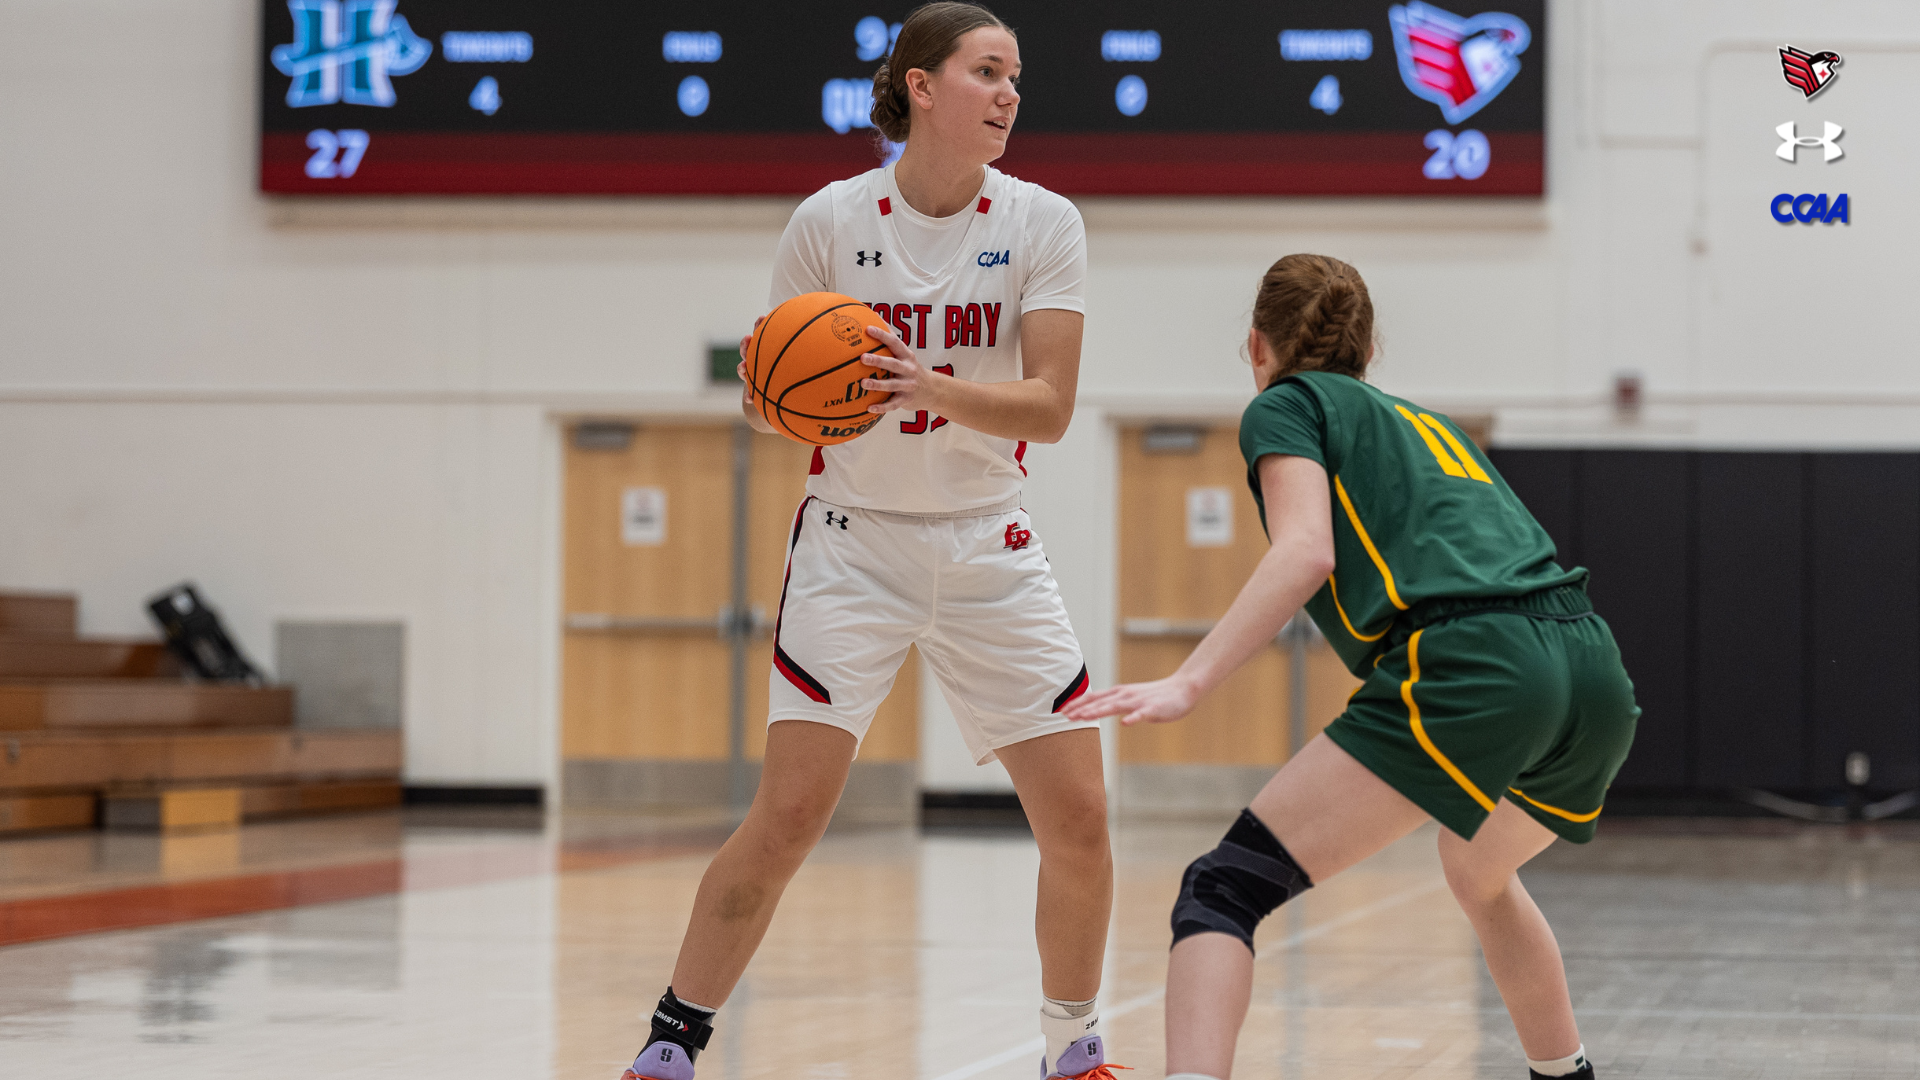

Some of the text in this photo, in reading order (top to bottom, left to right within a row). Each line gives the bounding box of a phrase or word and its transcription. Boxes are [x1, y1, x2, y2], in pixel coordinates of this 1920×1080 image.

[468, 76, 501, 115] 4
[677, 75, 710, 117] 0
[1115, 74, 1148, 117] 0
[1309, 74, 1343, 115] 4
[304, 129, 370, 179] 27
[1422, 129, 1491, 180] 20
[977, 250, 1010, 267] CCAA
[944, 302, 1002, 349] BAY
[823, 398, 843, 408] NXT
[1394, 404, 1494, 485] 11
